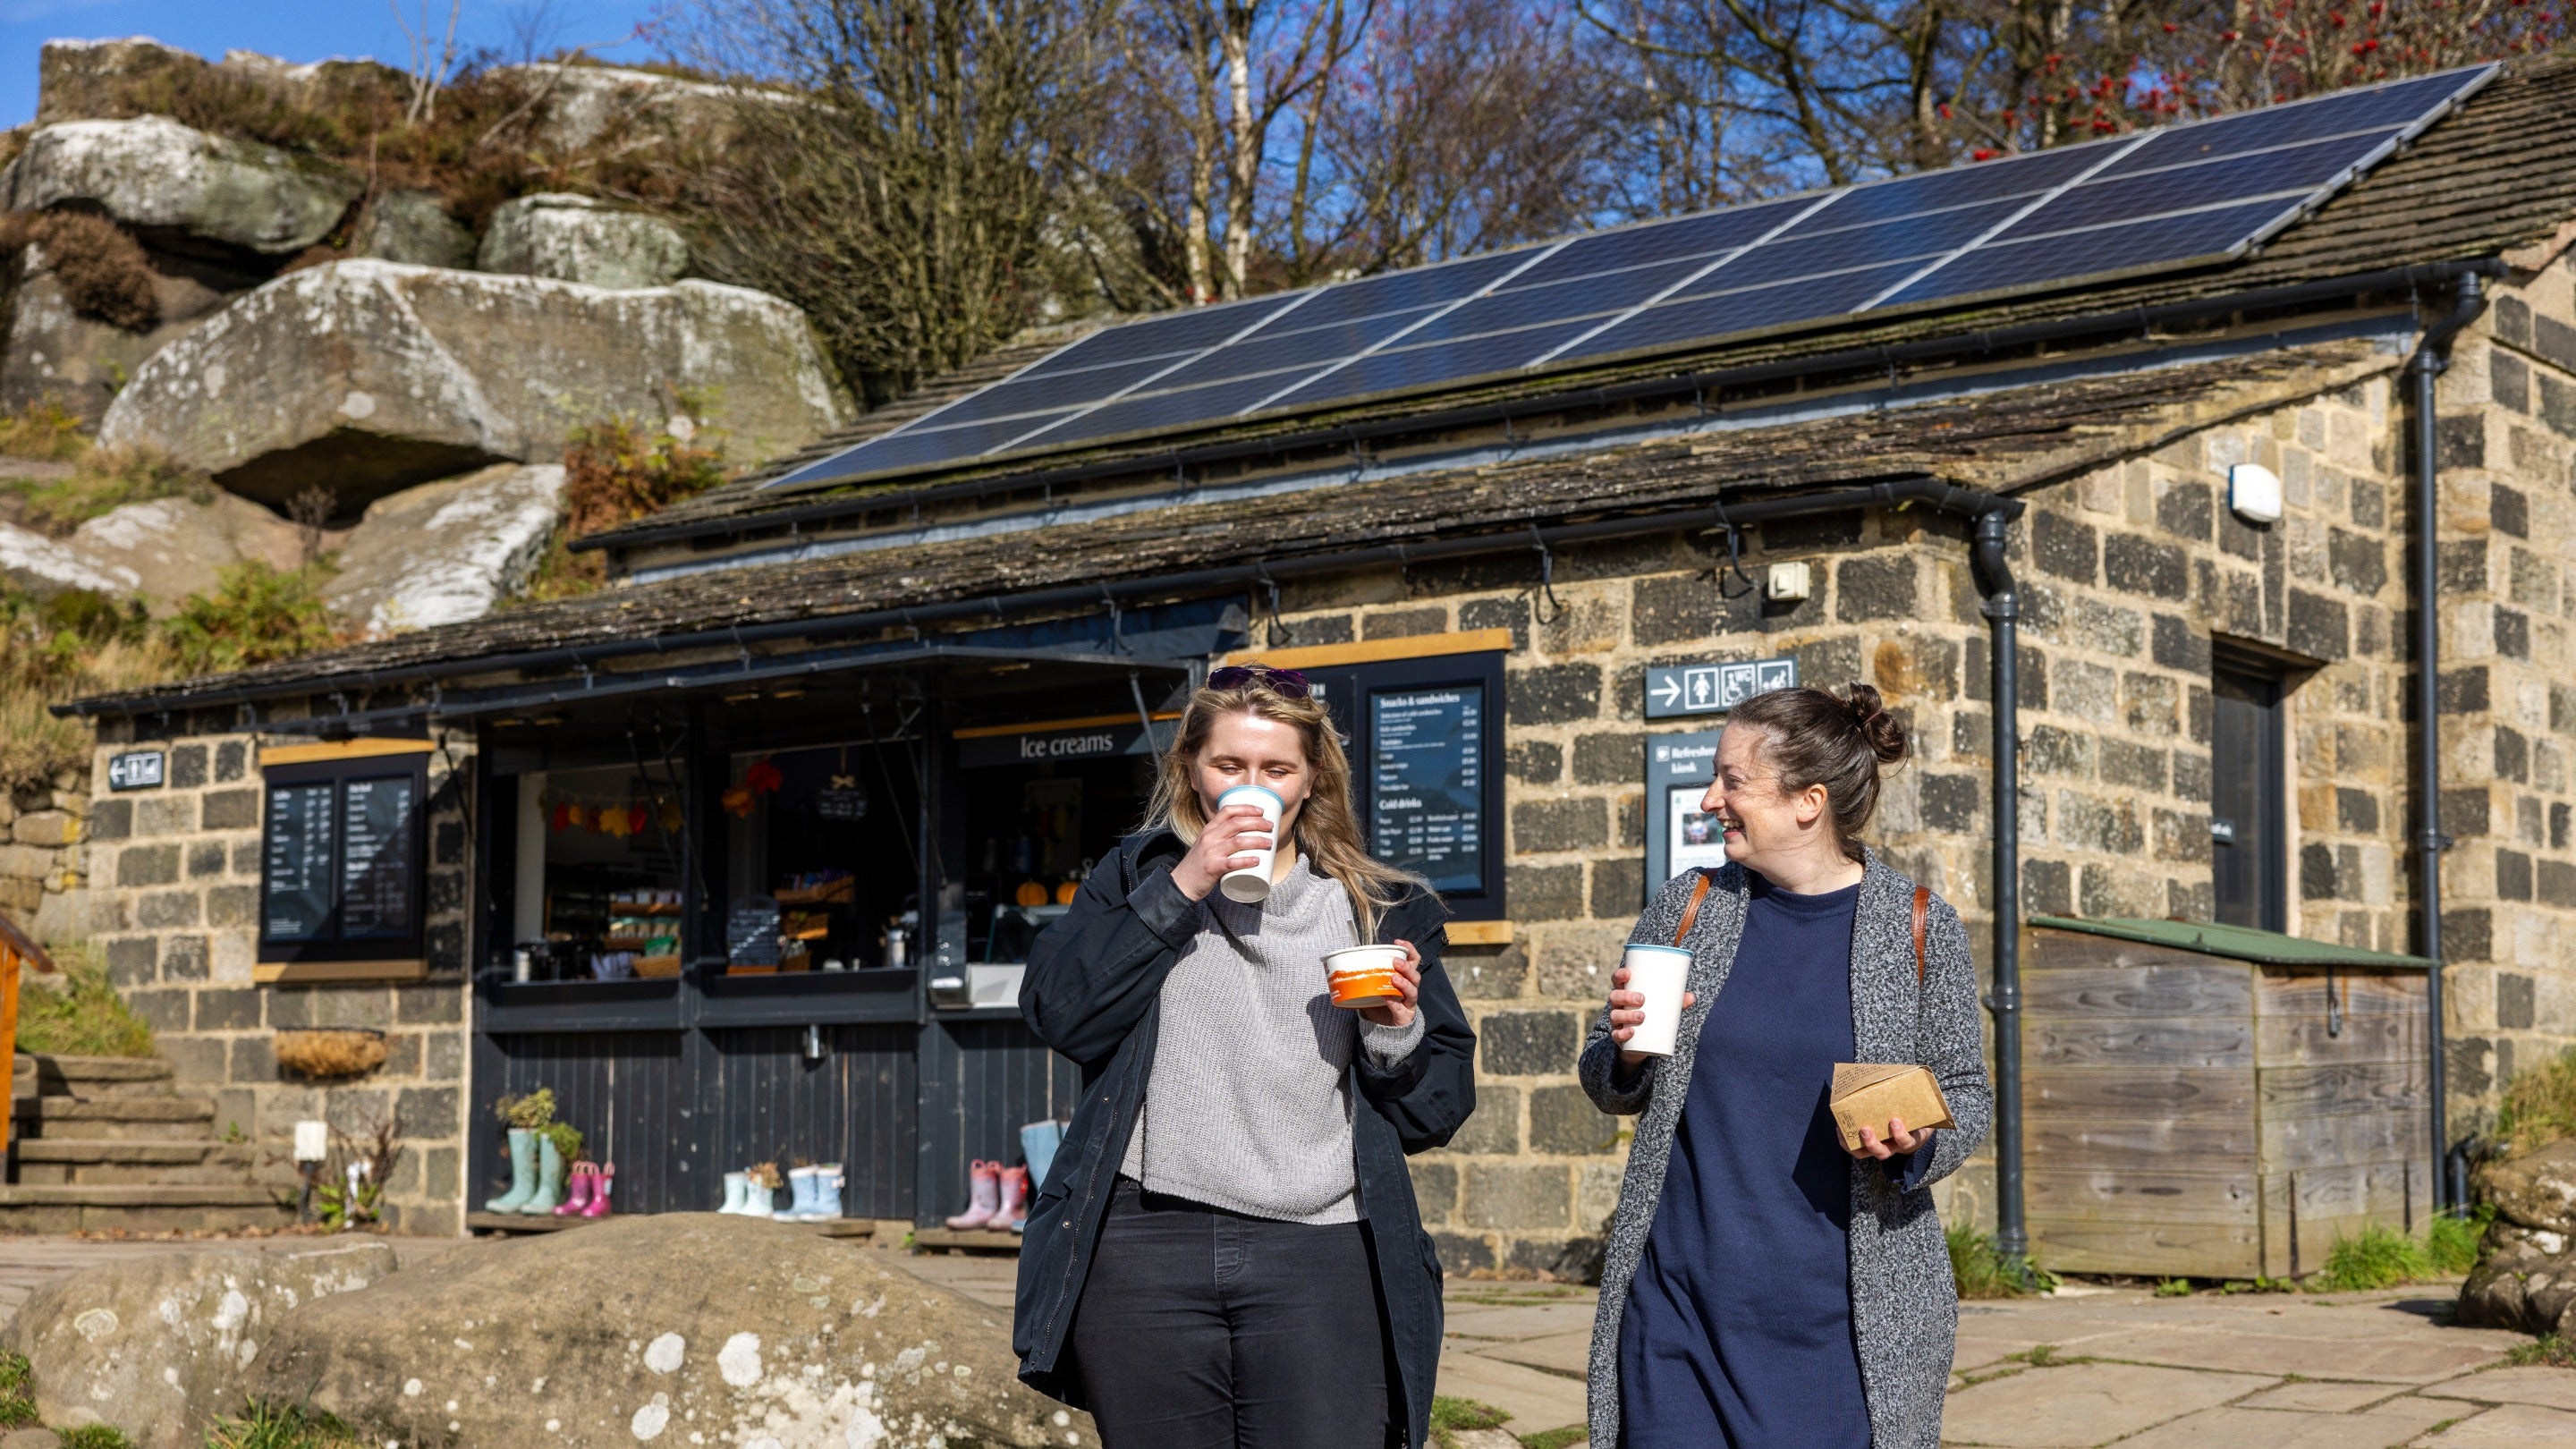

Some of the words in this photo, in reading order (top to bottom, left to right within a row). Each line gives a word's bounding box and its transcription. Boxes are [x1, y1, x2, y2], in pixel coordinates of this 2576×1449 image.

[1735, 668, 1751, 682] WC
[1380, 698, 1408, 708] Snacks
[1408, 696, 1415, 707] &
[1416, 692, 1461, 705] sandwiches
[1021, 736, 1047, 758] Ice
[1049, 733, 1114, 756] creams
[1672, 745, 1716, 759] Refreshm
[1671, 760, 1698, 775] kiosk
[1378, 799, 1398, 810] Cold
[1399, 797, 1422, 809] drinks
